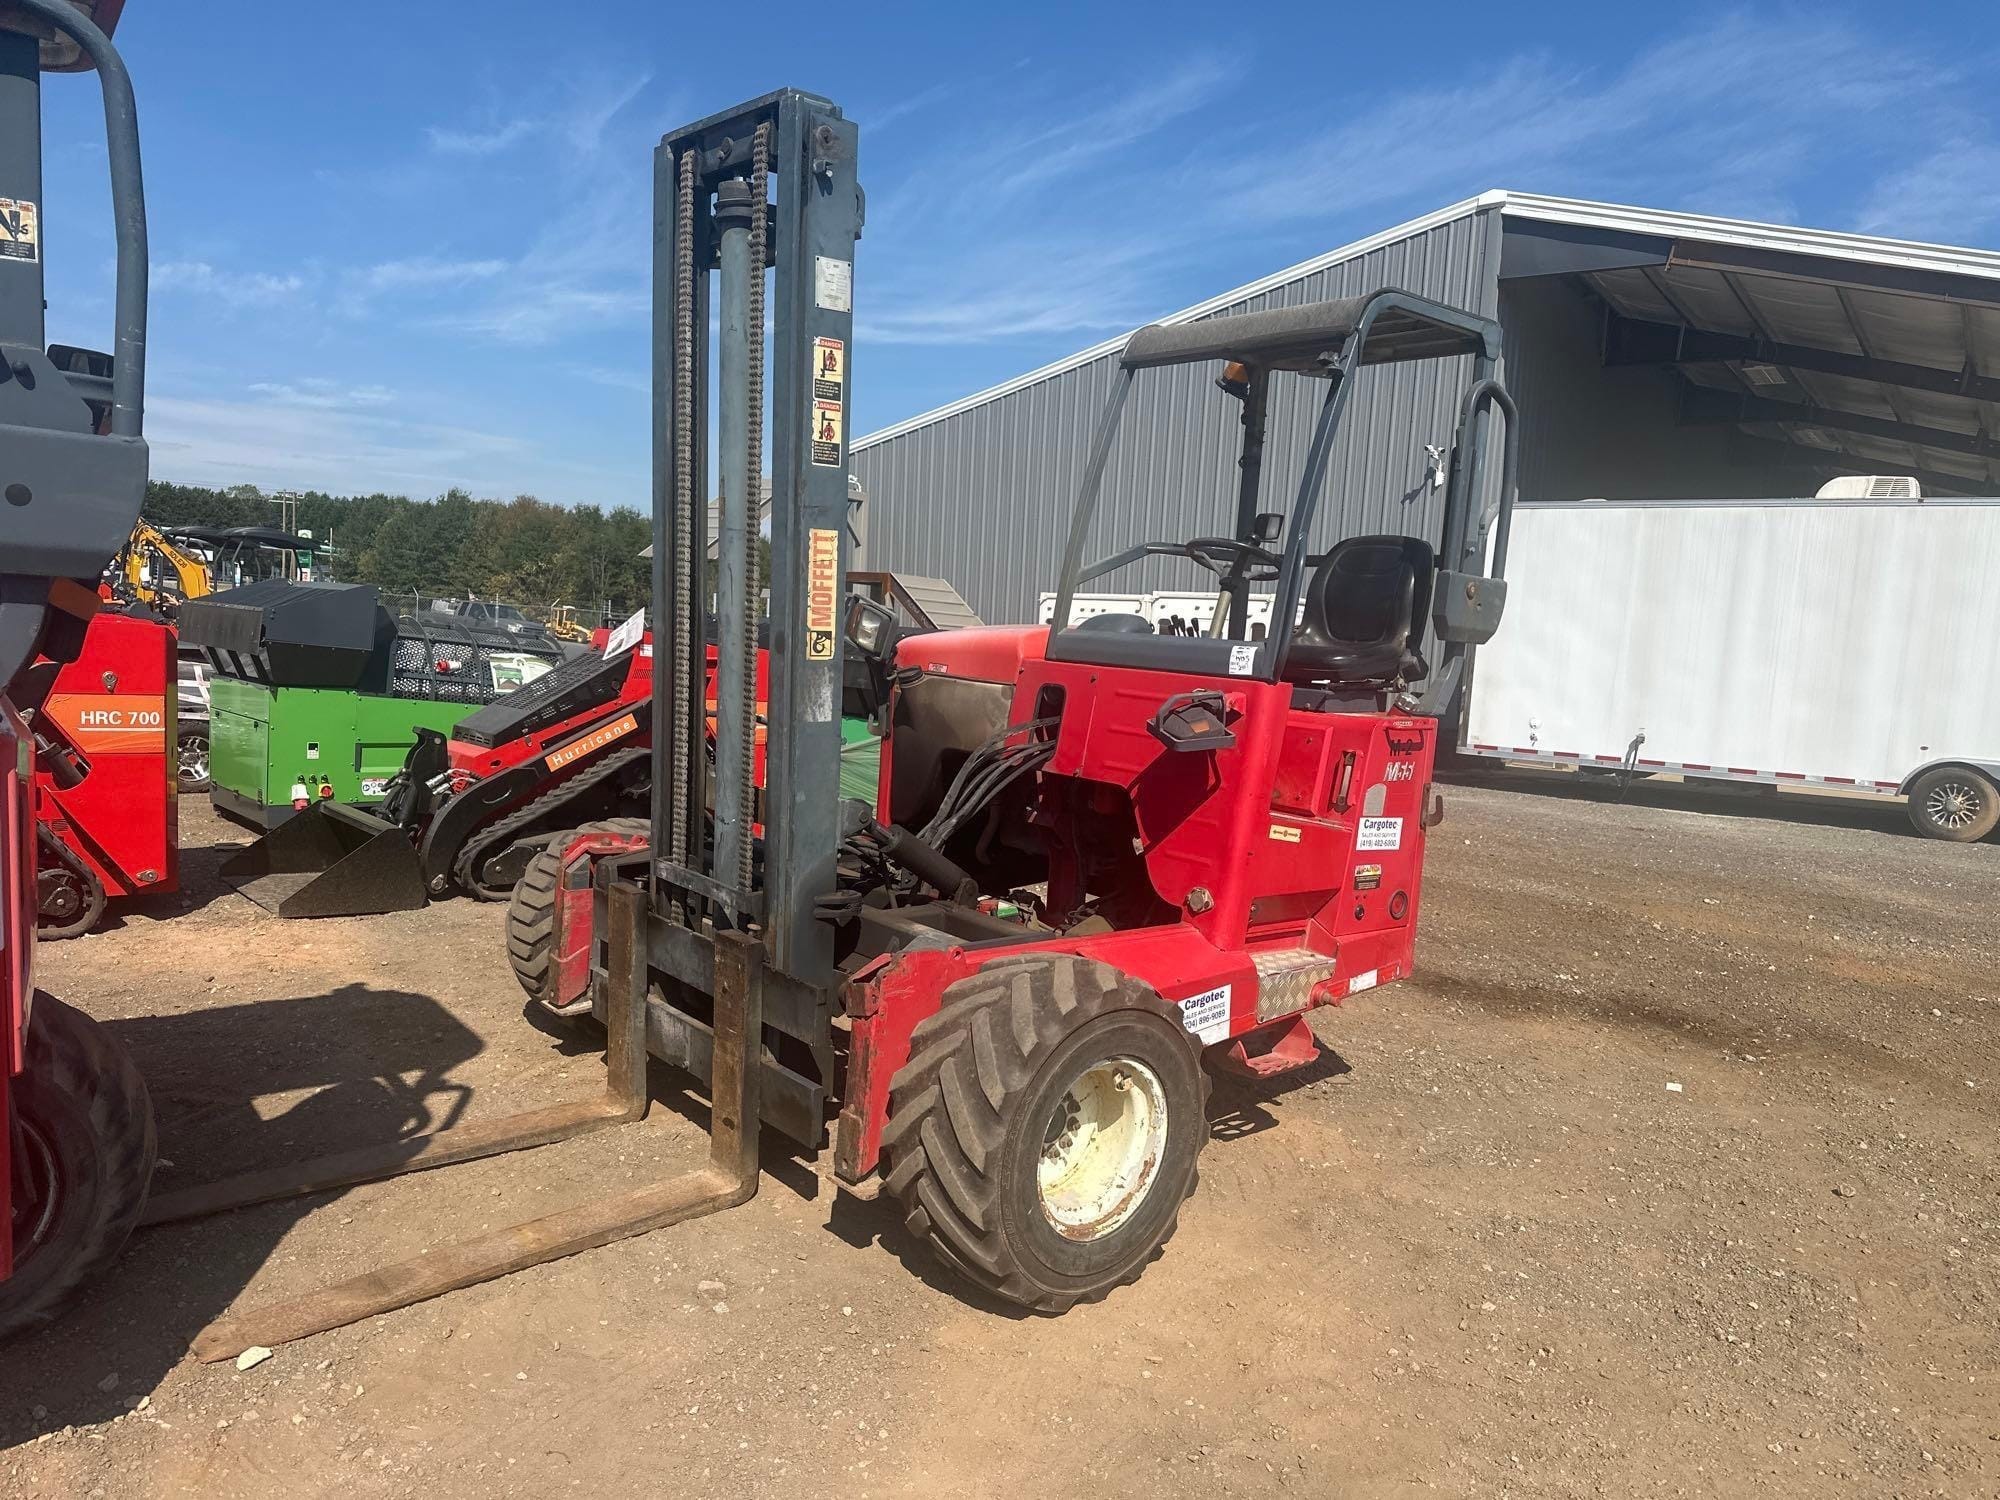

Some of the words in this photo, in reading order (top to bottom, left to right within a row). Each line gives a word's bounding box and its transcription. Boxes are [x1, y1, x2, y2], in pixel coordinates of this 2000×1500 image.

[811, 532, 833, 627] MOFFETT
[80, 710, 122, 725] HRC
[127, 711, 161, 725] 700
[552, 720, 631, 766] Hurricane
[1364, 819, 1397, 831] Cargotec
[1185, 990, 1225, 1010] Cargotec
[1198, 1007, 1207, 1015] AND
[1208, 1002, 1225, 1012] SERVICE
